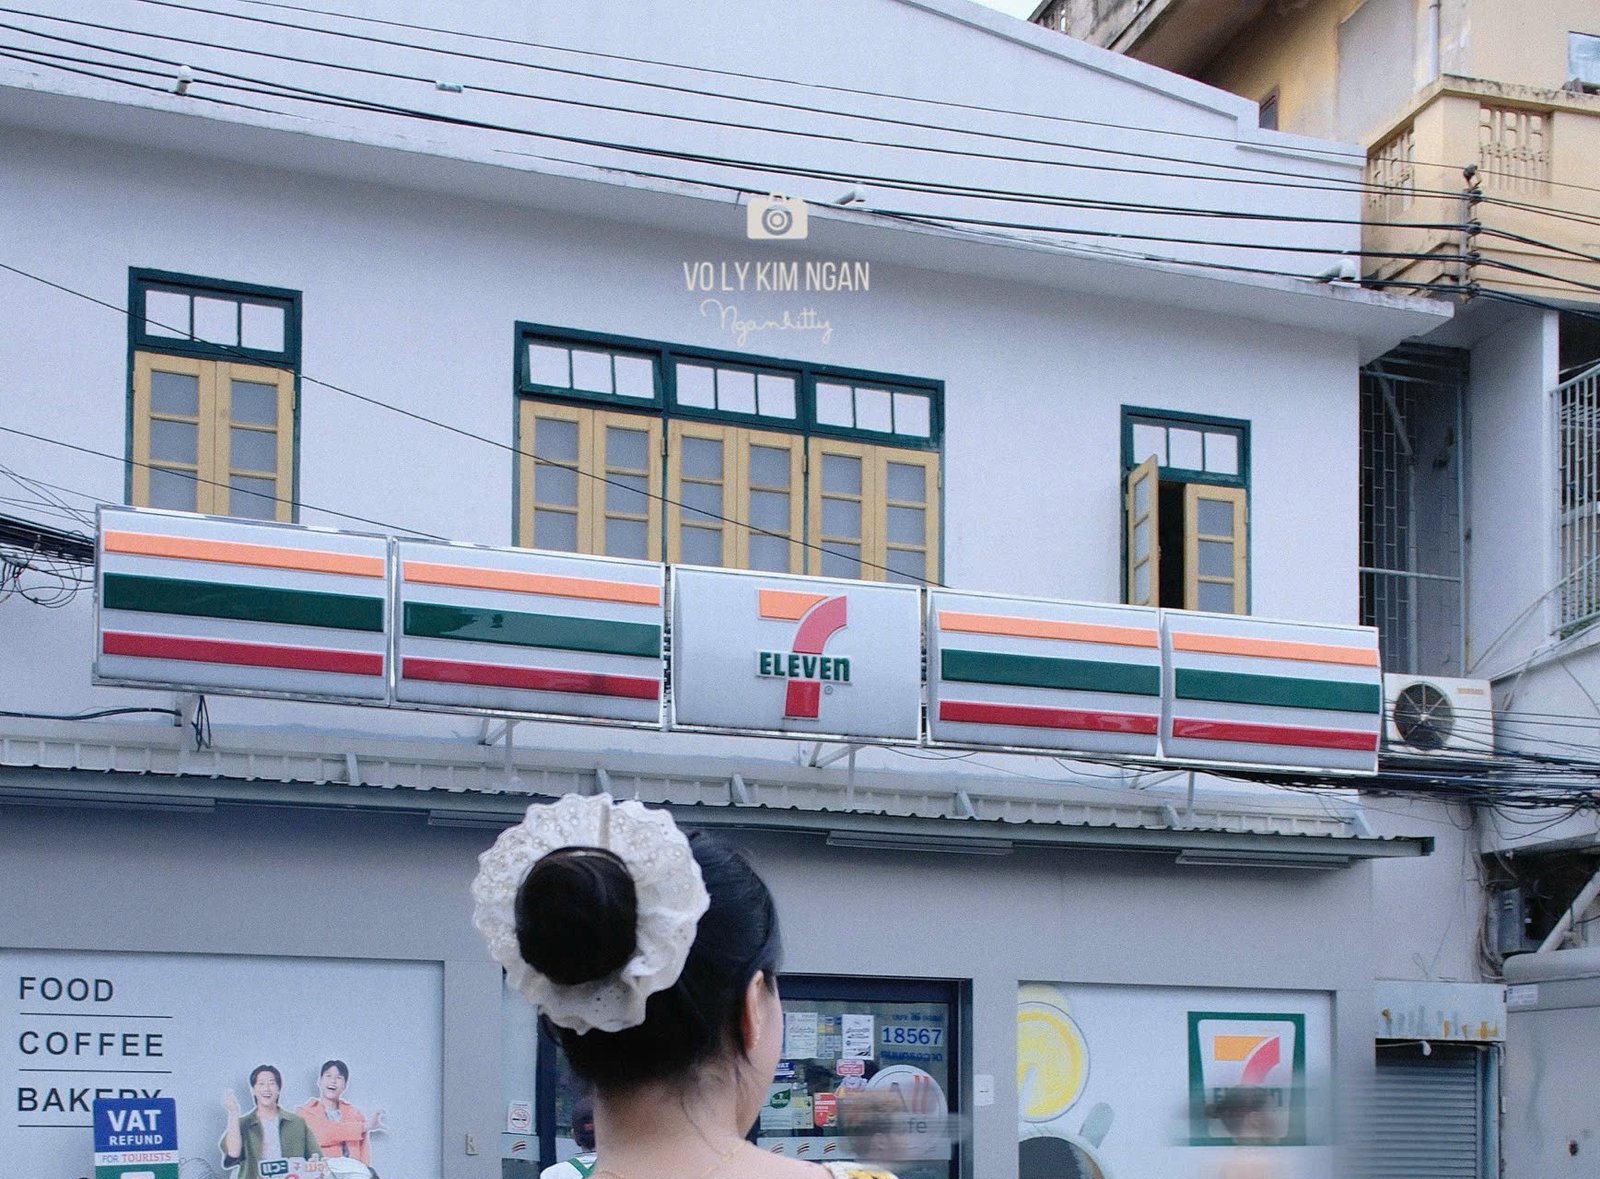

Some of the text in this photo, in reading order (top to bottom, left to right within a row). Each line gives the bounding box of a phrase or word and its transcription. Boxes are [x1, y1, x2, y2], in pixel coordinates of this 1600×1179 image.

[20, 976, 114, 1002] FOOD
[19, 1031, 163, 1057] COFFEE
[882, 1027, 942, 1045] 18567
[107, 1109, 162, 1132] VAT
[109, 1134, 163, 1146] REFUND
[102, 1152, 171, 1163] FOR TOURISTS
